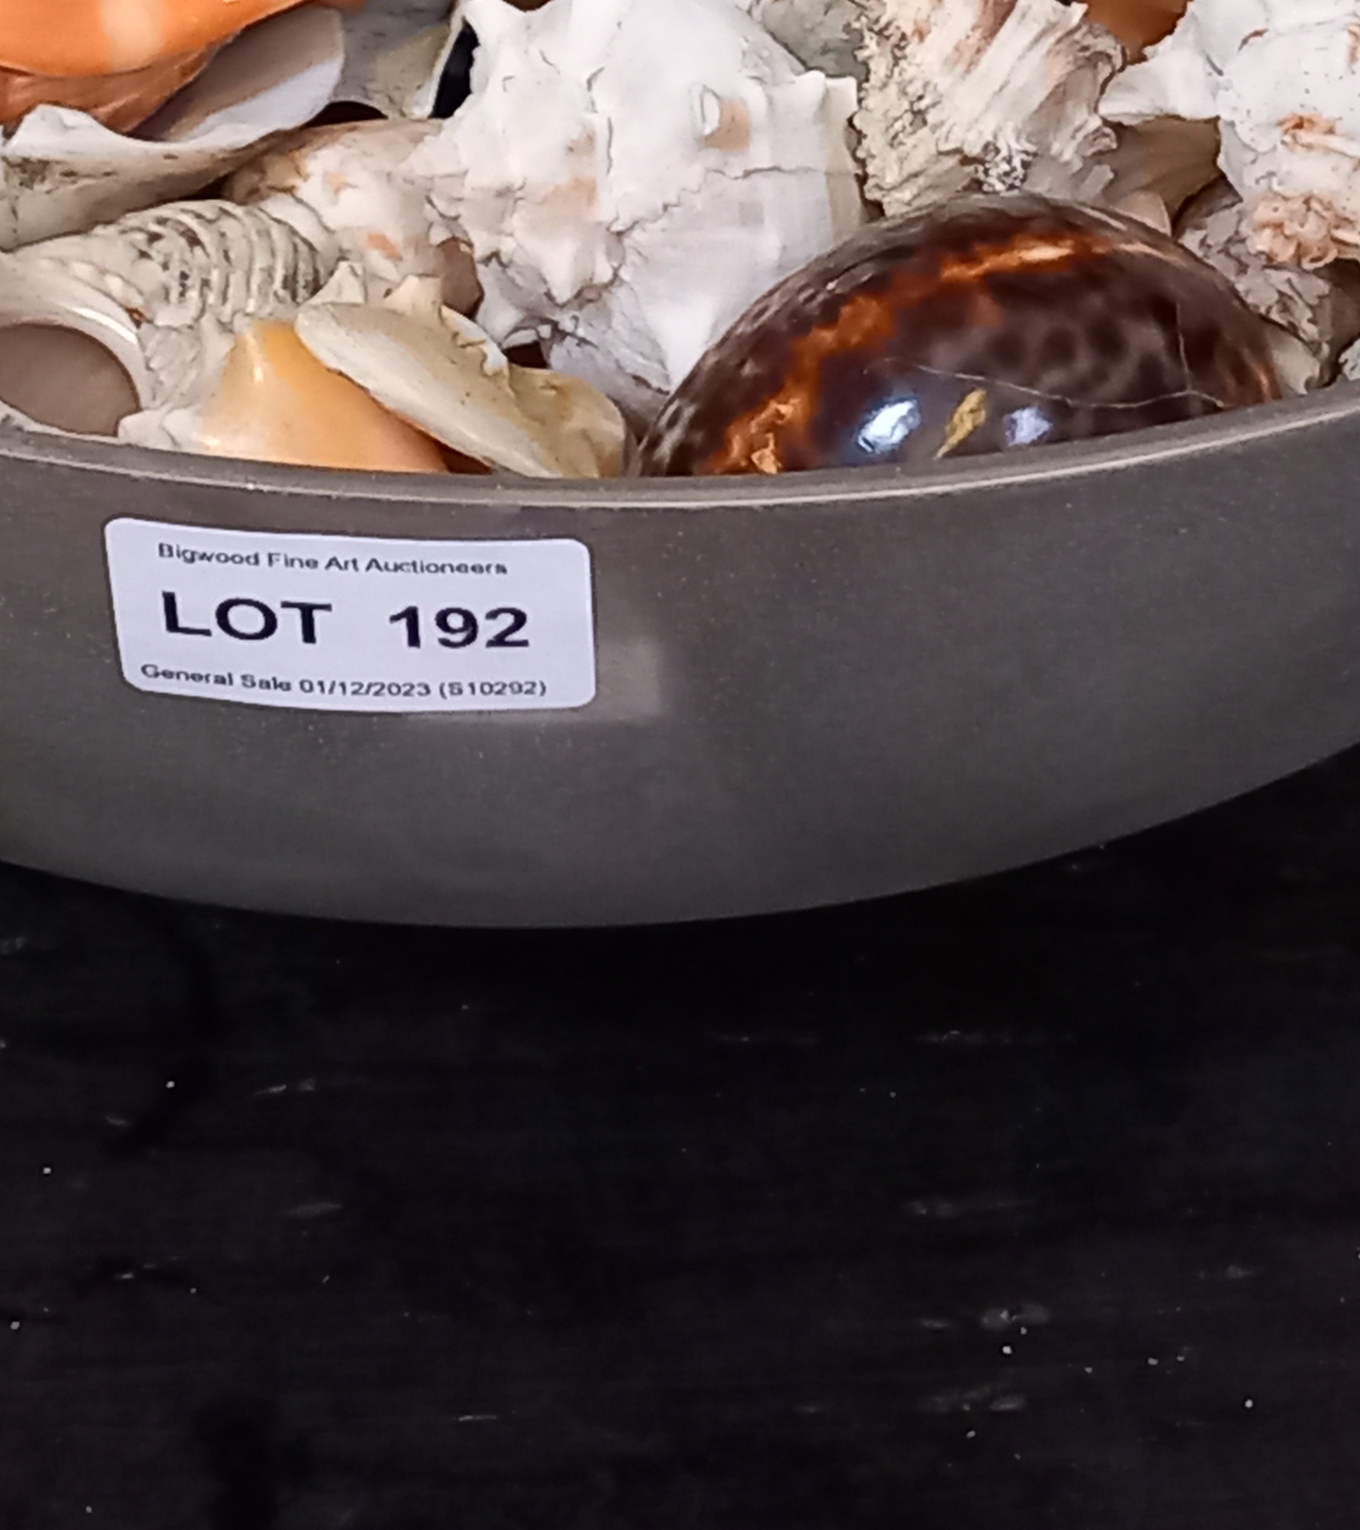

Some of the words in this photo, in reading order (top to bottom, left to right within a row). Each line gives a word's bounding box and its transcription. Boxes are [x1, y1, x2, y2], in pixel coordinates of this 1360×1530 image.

[158, 542, 260, 567] Bigwood
[267, 552, 319, 570] Fine
[325, 555, 360, 572] Art
[365, 557, 509, 575] Auctioneers
[161, 591, 333, 645] LOT
[388, 606, 530, 649] 192
[141, 663, 234, 687] General
[241, 673, 292, 692] Sale
[298, 678, 432, 698] 01/12/2023
